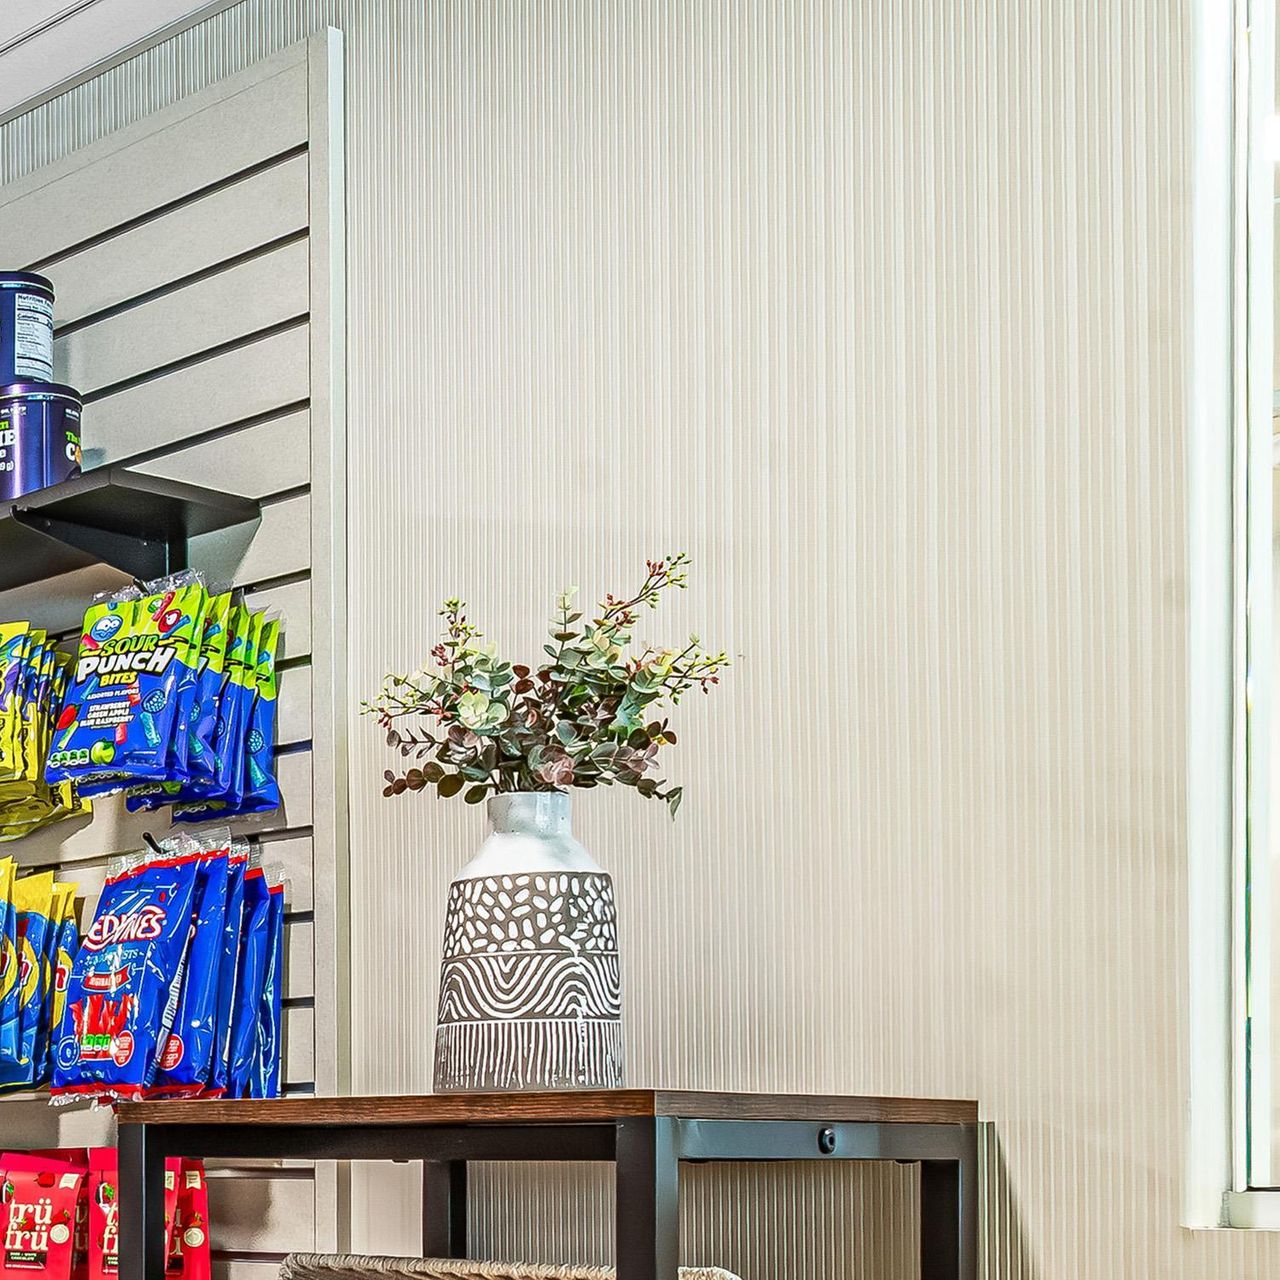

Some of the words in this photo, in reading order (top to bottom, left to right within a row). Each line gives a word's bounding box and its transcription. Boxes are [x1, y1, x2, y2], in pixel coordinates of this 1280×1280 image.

[100, 635, 159, 656] SOUR
[77, 646, 176, 683] PUNCH
[100, 672, 138, 686] BITES
[87, 710, 108, 719] GREEN
[109, 708, 130, 717] APPLE
[89, 700, 131, 711] STRAWBERRY
[97, 715, 134, 726] RASPBERRY
[9, 1198, 52, 1224] trü
[5, 1223, 48, 1250] frü
